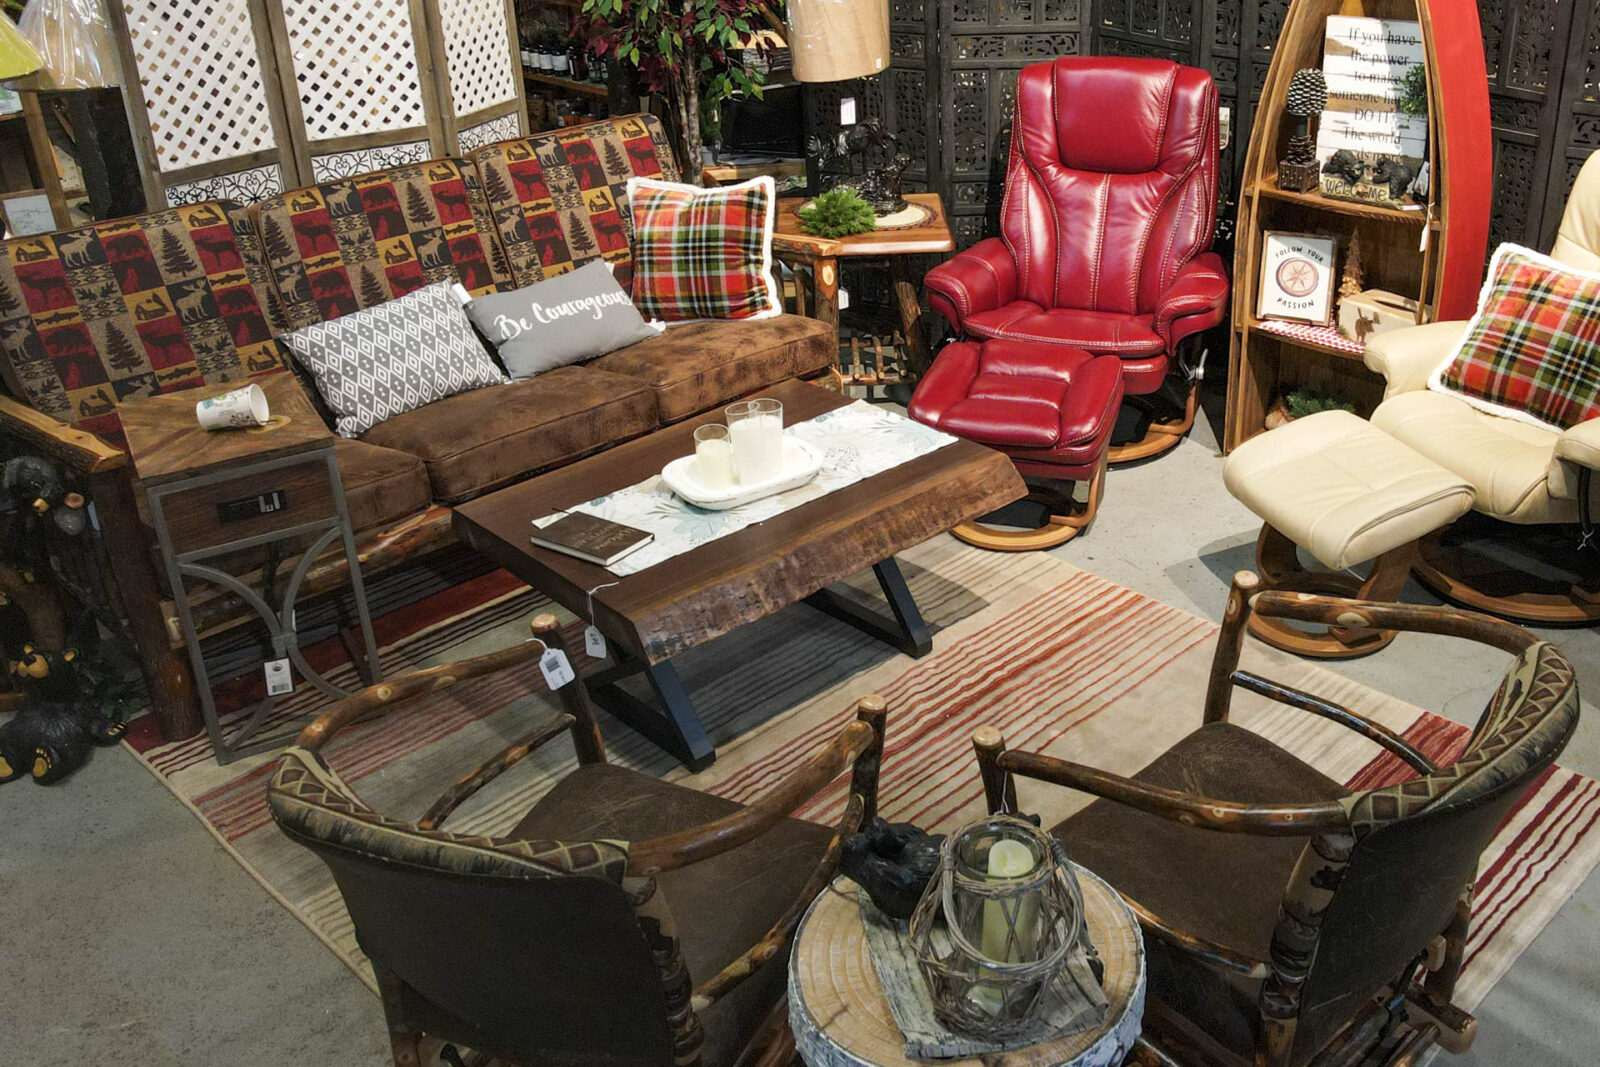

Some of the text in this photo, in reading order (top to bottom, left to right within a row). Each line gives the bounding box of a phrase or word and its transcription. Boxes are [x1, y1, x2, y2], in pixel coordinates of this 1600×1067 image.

[1349, 27, 1416, 45] If you have
[1350, 48, 1410, 66] the power
[1354, 71, 1402, 85] to make
[1329, 90, 1380, 103] someone
[1354, 107, 1374, 120] DO
[1343, 127, 1402, 145] The world
[1275, 246, 1324, 263] FOLLOW YOUR
[1276, 298, 1315, 309] PASSION
[493, 290, 633, 341] Be Courageous
